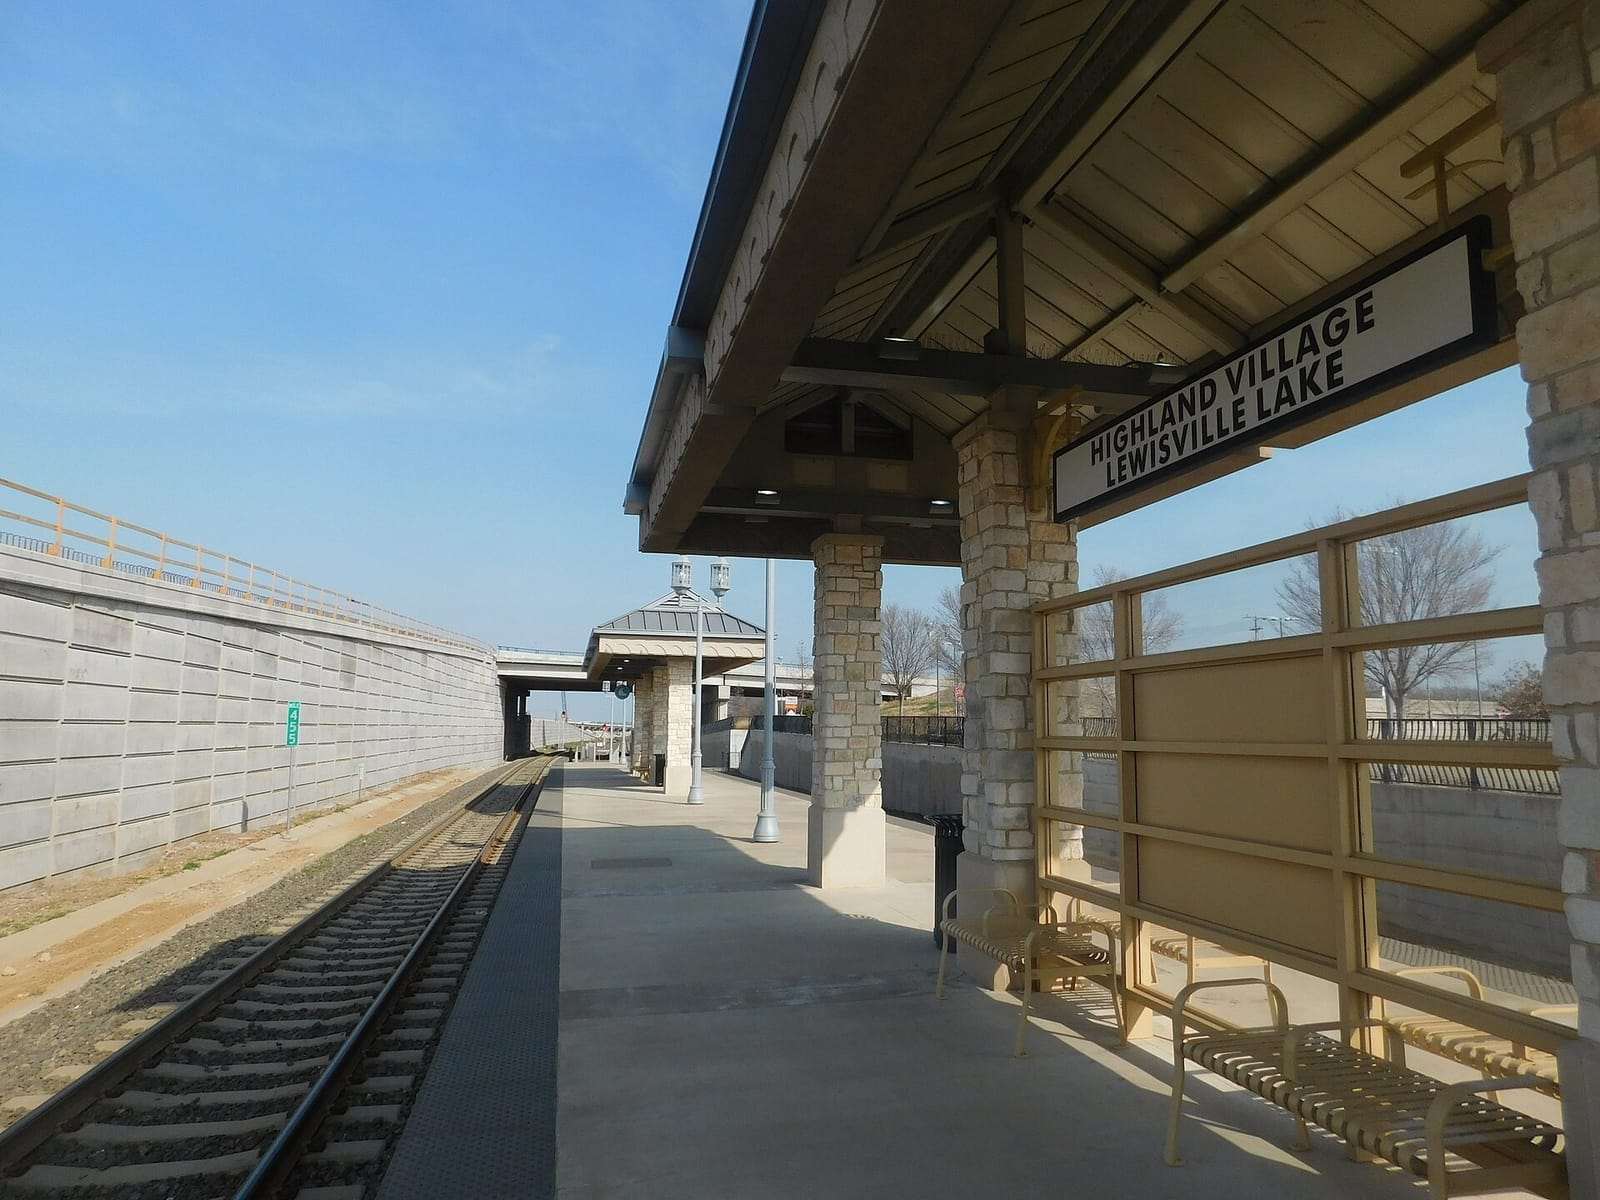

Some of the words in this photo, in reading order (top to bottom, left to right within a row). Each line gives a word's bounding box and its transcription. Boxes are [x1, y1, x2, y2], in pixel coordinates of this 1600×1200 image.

[1091, 378, 1217, 466] HIGHLAND
[1225, 290, 1375, 395] VILLAGE
[1107, 396, 1246, 488] LEWISVILLE
[1256, 349, 1344, 421] LAKE
[288, 710, 297, 744] 455
